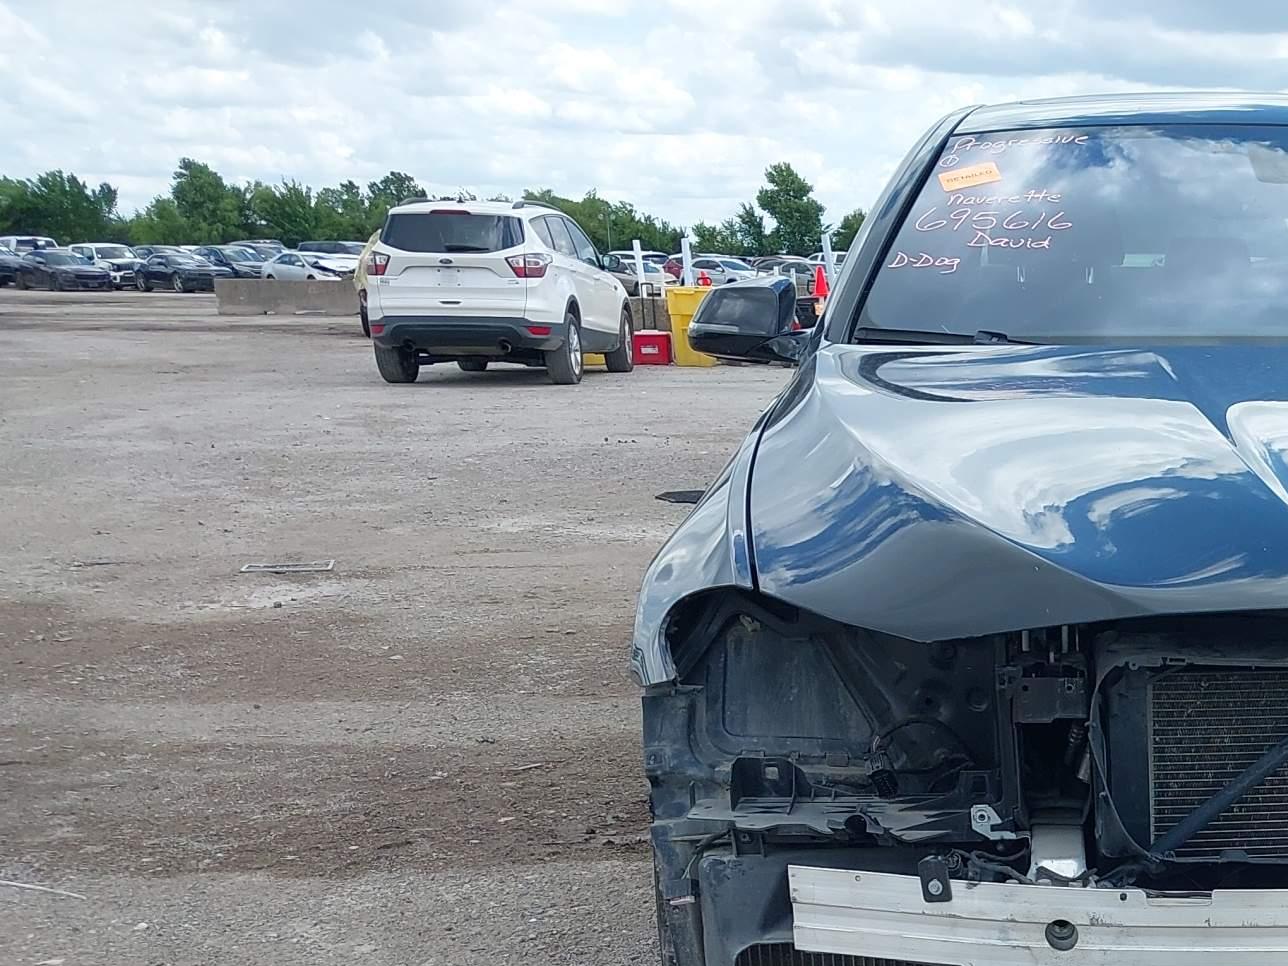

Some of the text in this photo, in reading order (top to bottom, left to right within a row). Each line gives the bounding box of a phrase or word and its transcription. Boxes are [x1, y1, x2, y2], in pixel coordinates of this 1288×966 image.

[951, 135, 1088, 154] Progressive
[914, 207, 1073, 231] 695616
[967, 230, 1052, 249] David
